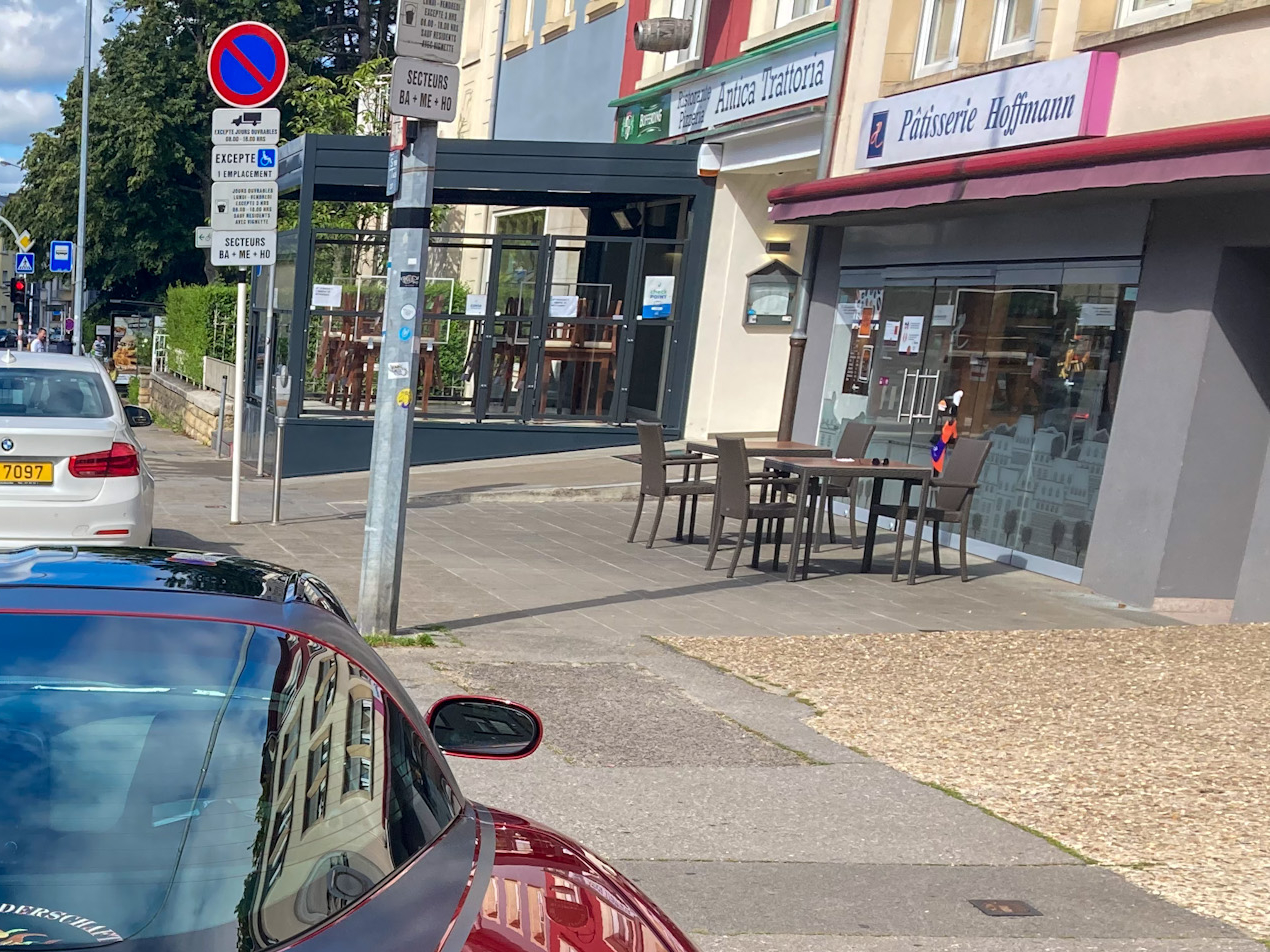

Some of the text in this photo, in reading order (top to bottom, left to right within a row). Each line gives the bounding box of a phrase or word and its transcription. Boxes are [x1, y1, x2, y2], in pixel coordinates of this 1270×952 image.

[424, 8, 443, 18] EXCEPTE
[407, 70, 448, 90] SECTEURS
[715, 52, 824, 114] Antica Trattoria
[399, 90, 410, 105] BA
[420, 92, 431, 108] ME
[441, 96, 452, 111] HO
[677, 85, 712, 109] Ristorante
[679, 110, 704, 129] Pizzeria
[898, 98, 978, 142] Pâtisserie
[984, 92, 1076, 136] Hoffmann
[216, 154, 256, 164] EXCEPTE
[225, 238, 265, 247] SECTEURS
[219, 250, 229, 259] BA
[239, 250, 250, 258] ME
[260, 250, 270, 258] HO
[4, 464, 43, 479] 7097
